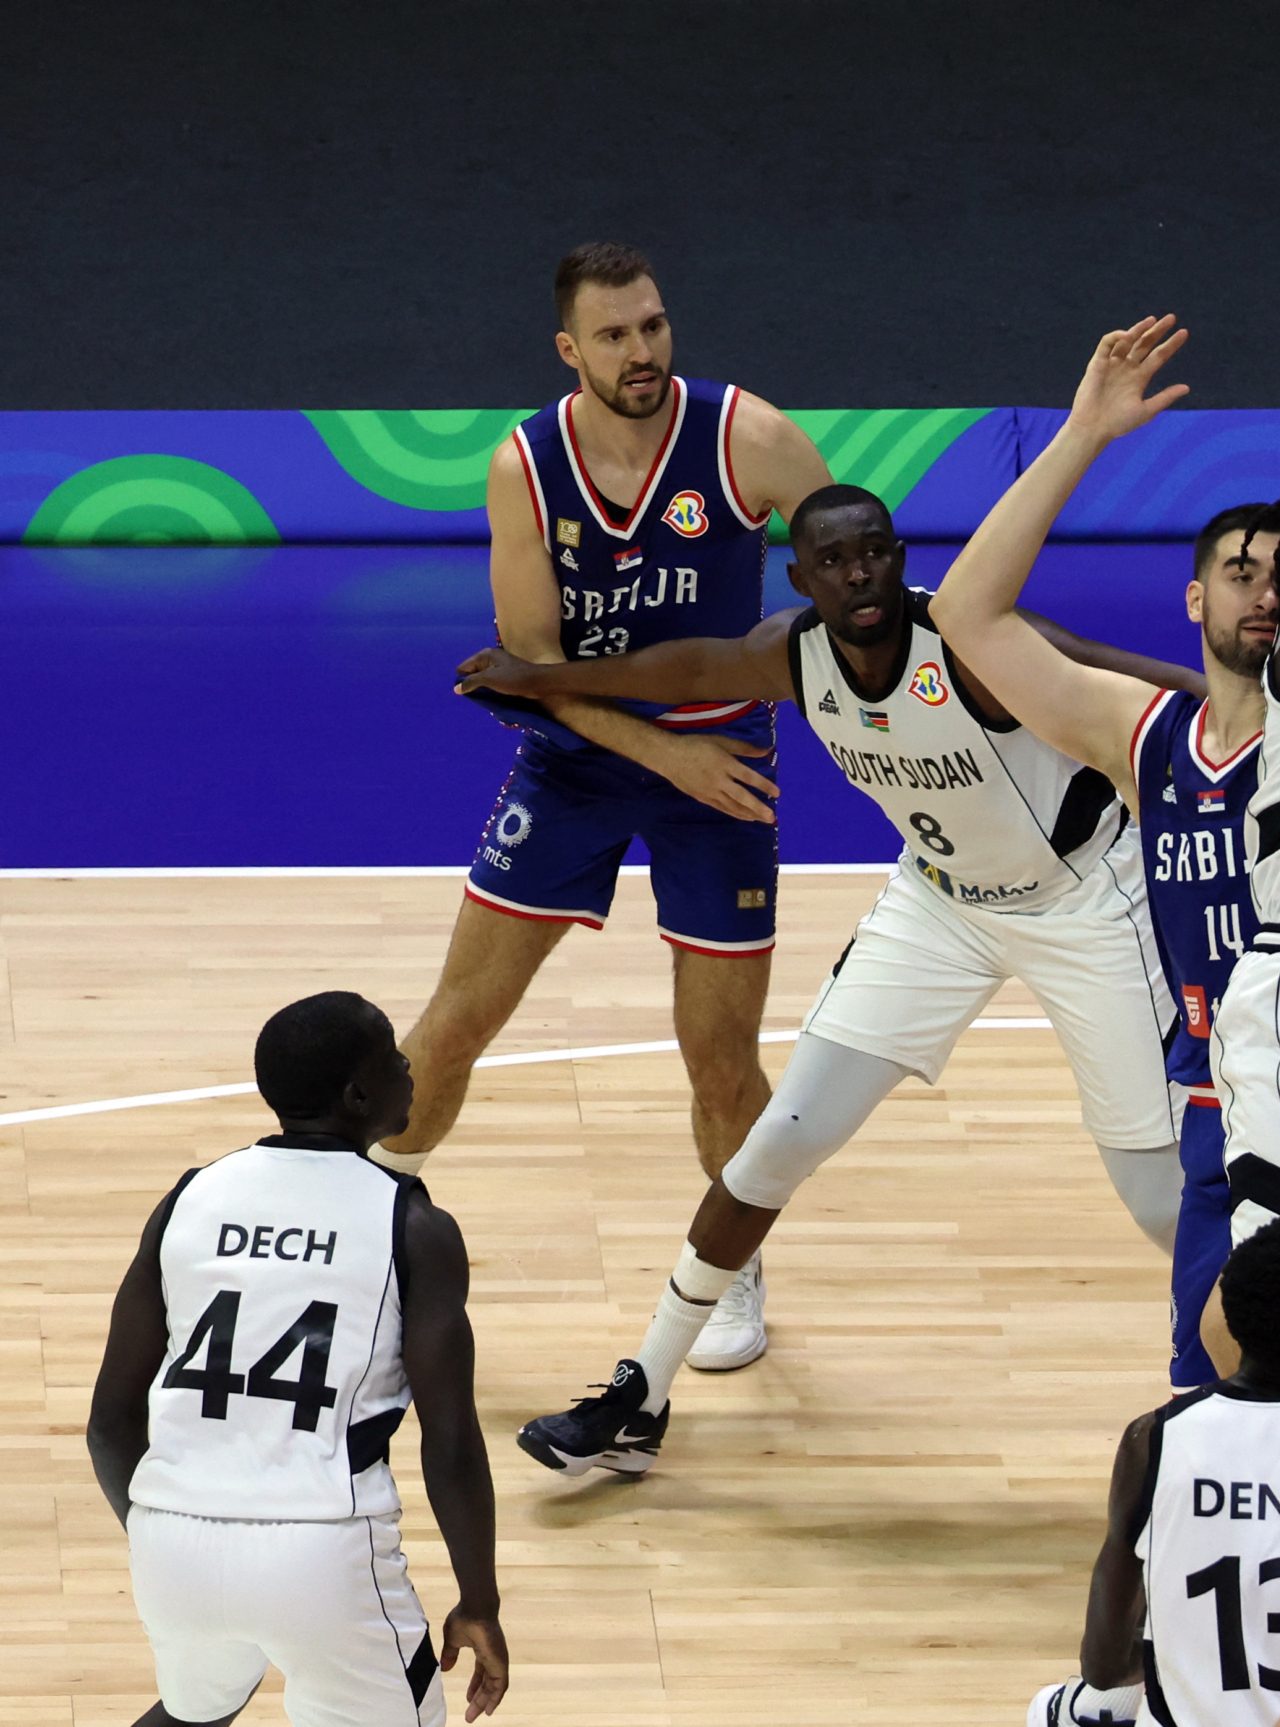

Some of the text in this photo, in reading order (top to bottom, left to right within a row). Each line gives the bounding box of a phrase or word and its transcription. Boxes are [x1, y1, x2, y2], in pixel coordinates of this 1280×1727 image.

[577, 624, 630, 657] 23
[830, 741, 984, 790] SOUTH SUDAN
[909, 812, 955, 856] 8
[1155, 828, 1250, 881] SRBI
[482, 845, 513, 871] mts
[1204, 903, 1244, 961] 14
[216, 1223, 337, 1265] DECH
[161, 1289, 338, 1432] 44
